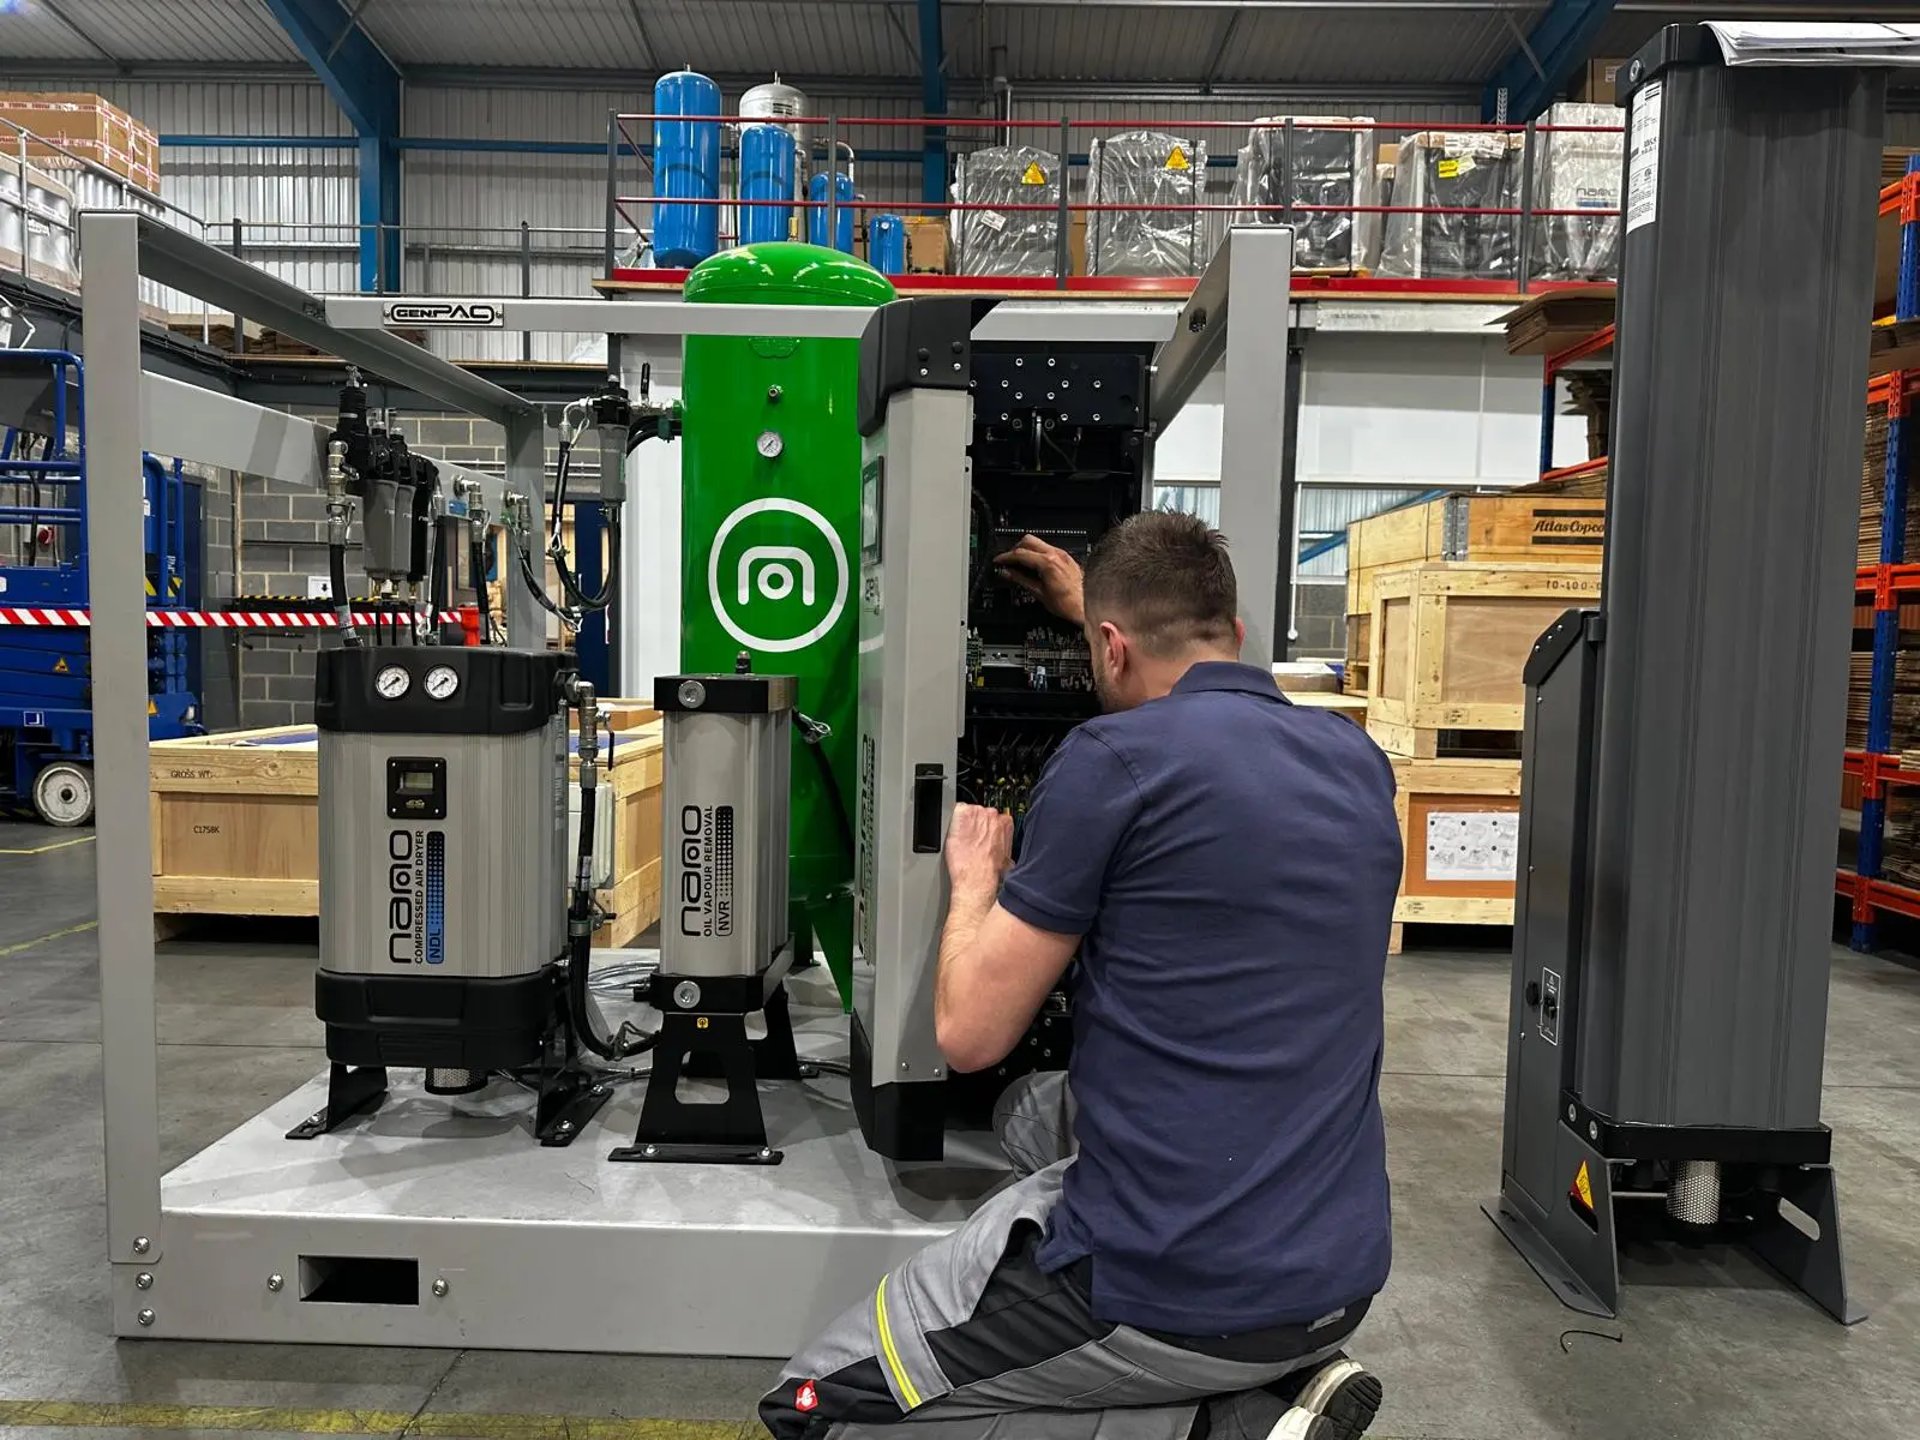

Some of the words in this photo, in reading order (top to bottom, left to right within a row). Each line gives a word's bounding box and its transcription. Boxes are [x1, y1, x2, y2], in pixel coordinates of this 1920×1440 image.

[414, 830, 425, 867] DRYER
[703, 805, 713, 862] REMOVAL
[414, 868, 425, 888] AIR
[703, 865, 713, 915] VAPOUR
[414, 890, 425, 965] COMPRESSED
[703, 917, 713, 937] OIL
[718, 900, 730, 931] NVR
[429, 928, 442, 958] NDL
